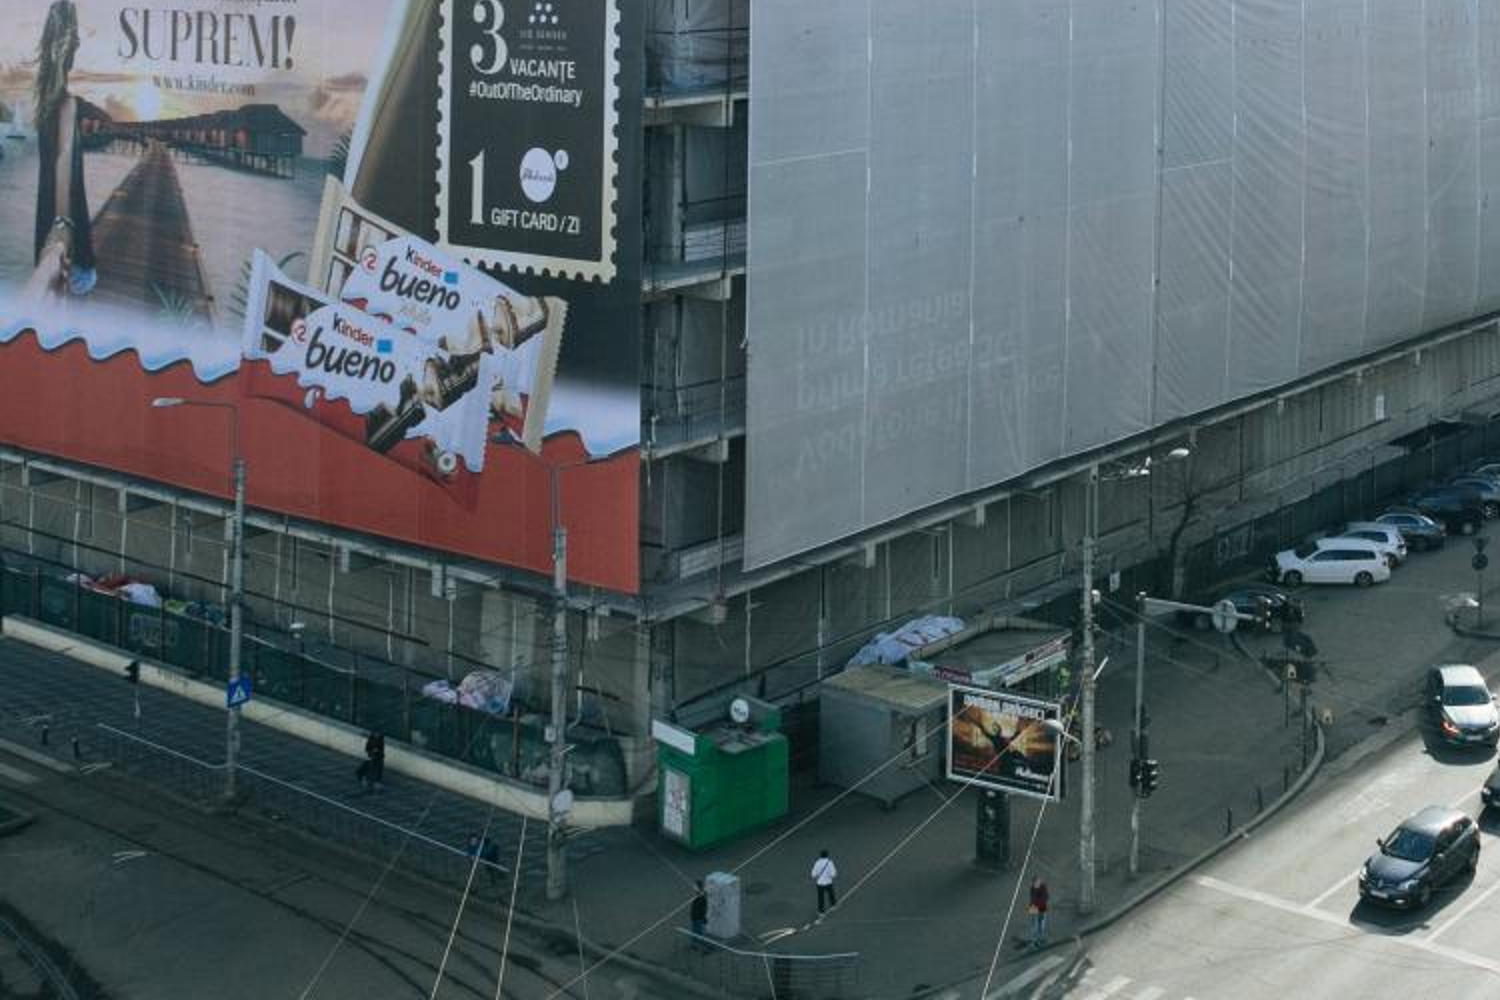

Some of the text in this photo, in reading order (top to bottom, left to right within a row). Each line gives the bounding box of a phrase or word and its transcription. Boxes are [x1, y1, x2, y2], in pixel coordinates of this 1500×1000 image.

[117, 6, 297, 70] SUPREM!
[469, 81, 583, 107] #OutOfTheOrdinary
[468, 149, 484, 224] 1
[491, 208, 518, 228] GIFT
[521, 211, 557, 231] CARD
[406, 245, 442, 277] kinder
[380, 256, 461, 311] bueno
[333, 312, 374, 346] kinder
[305, 327, 396, 384] bueno
